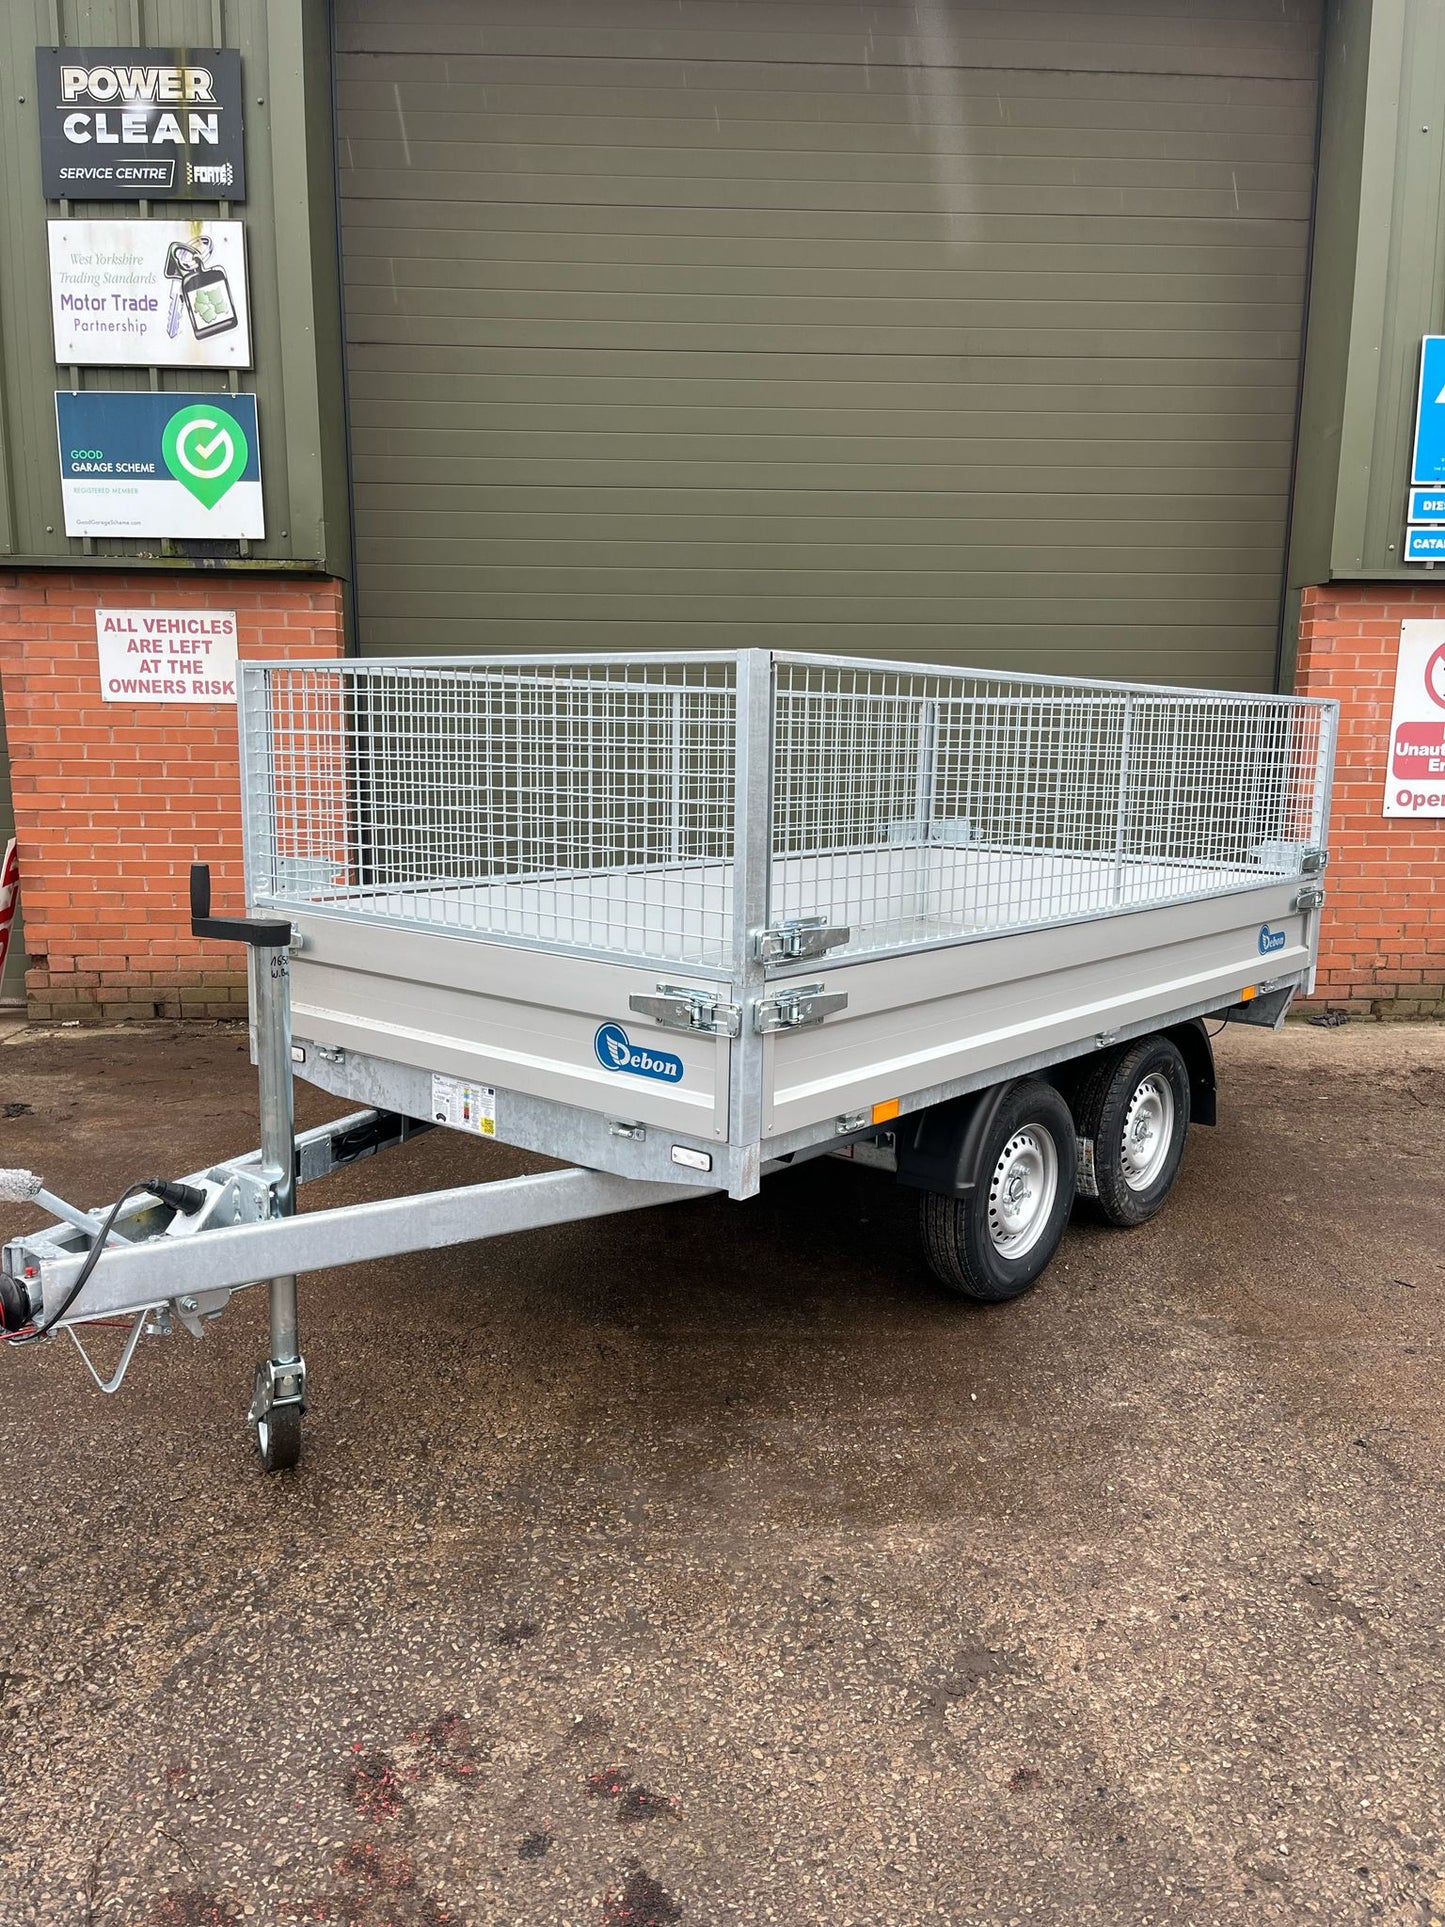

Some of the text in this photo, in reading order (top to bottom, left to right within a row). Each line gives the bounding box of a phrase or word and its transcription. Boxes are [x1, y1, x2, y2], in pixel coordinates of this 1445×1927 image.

[61, 66, 216, 102] POWER
[63, 113, 219, 144] CLEAN
[59, 167, 167, 180] SERVICE CENTRE
[70, 252, 144, 266] West Yorkshire
[59, 272, 157, 287] Trading Standards
[60, 293, 158, 312] Motor Trade
[74, 317, 148, 336] Partnership
[70, 449, 103, 460] GOOD
[71, 462, 155, 473] GARAGE SCHEME
[73, 487, 139, 495] REGISTERED MEMBER
[104, 617, 233, 635] ALL VEHICLES
[127, 639, 213, 654] ARE LEFT
[140, 659, 203, 674] AT THE
[108, 678, 236, 695] OWNERS RISK
[606, 1034, 677, 1077] Debon
